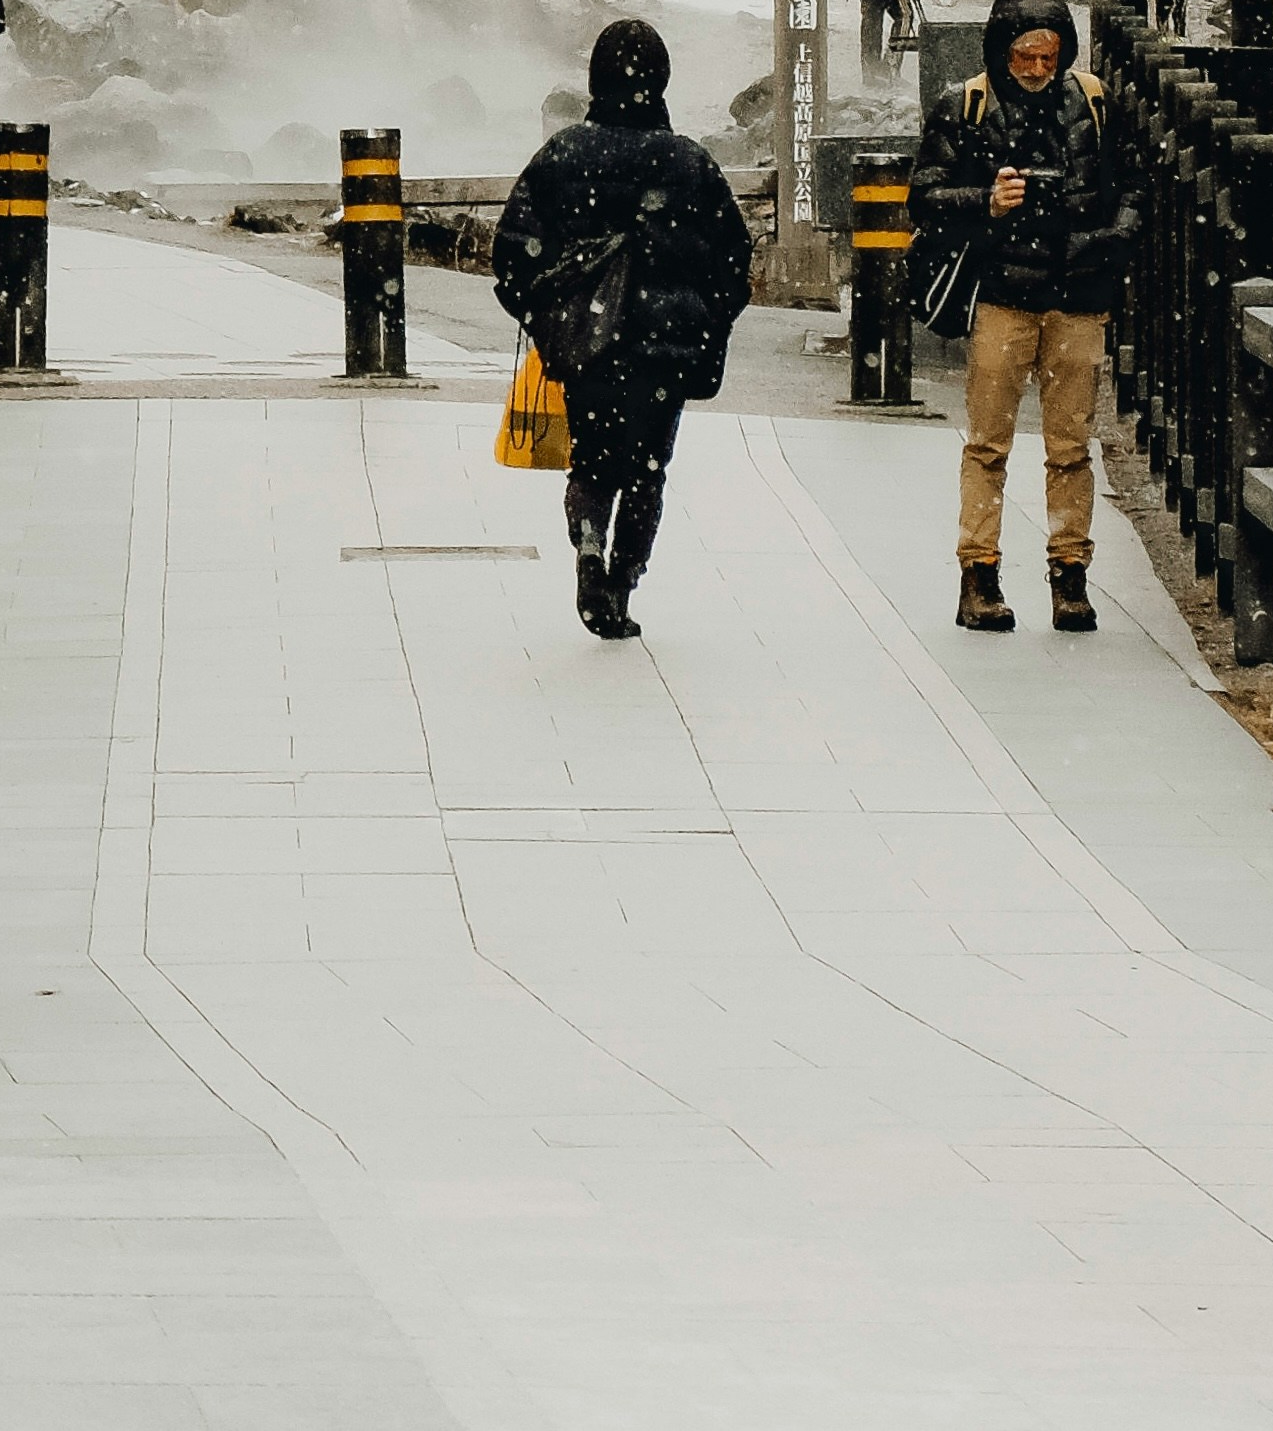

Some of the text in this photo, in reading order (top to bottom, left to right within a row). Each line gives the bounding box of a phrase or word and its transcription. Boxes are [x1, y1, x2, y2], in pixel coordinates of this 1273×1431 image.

[792, 42, 814, 225] 上信越高原国立公園
